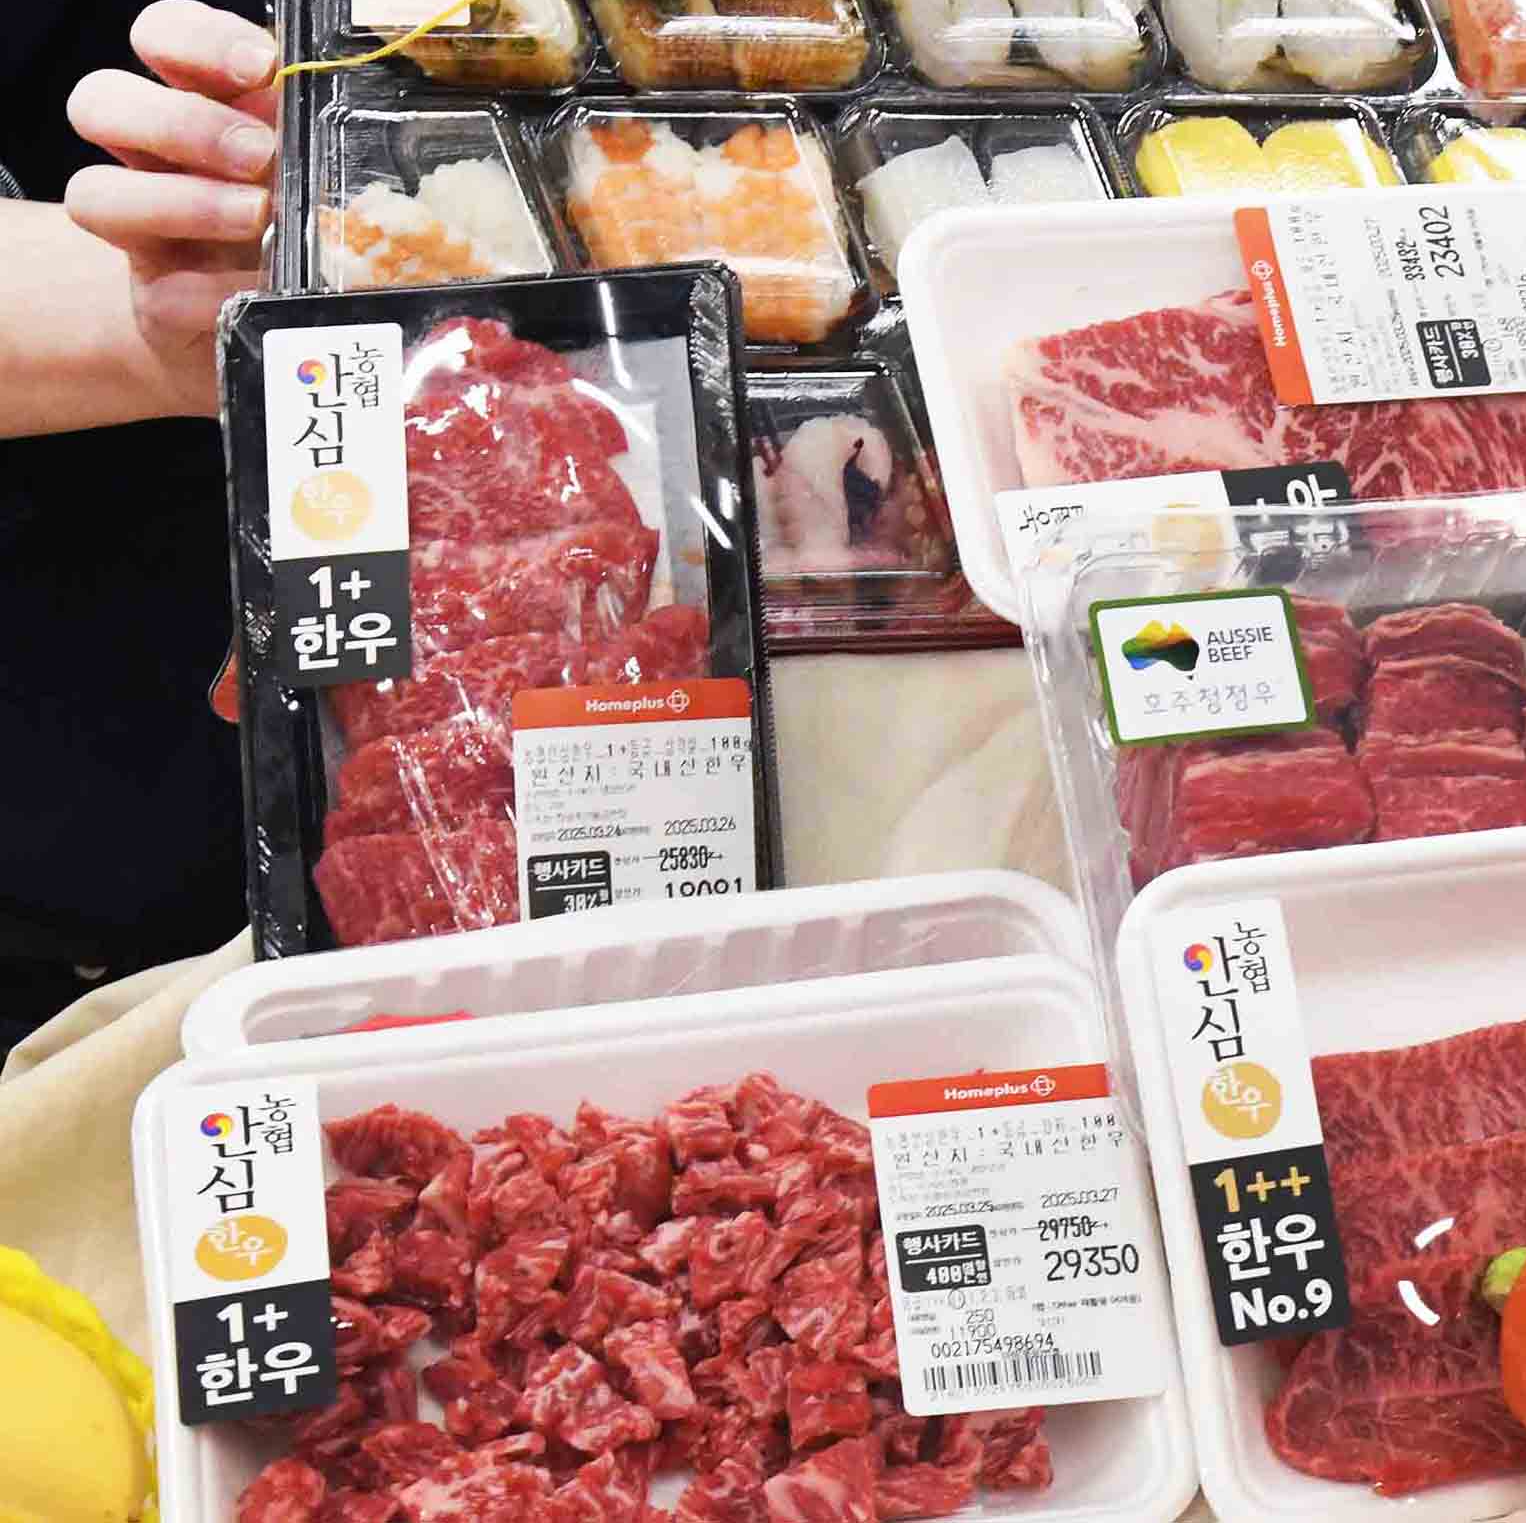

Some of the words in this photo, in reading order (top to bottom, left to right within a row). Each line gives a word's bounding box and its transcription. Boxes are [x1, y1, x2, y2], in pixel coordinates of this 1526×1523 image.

[1419, 205, 1464, 278] 23402
[1263, 280, 1287, 348] Homeplus
[351, 342, 384, 409] 농협
[292, 352, 353, 468] 안심
[307, 565, 372, 609] 1+
[290, 612, 397, 671] 한우
[1206, 626, 1274, 645] AUSSIE
[1207, 645, 1254, 663] BEEF
[585, 699, 664, 713] Homeplus
[1232, 921, 1271, 995] 농협
[1184, 935, 1245, 1062] 안심
[944, 1083, 1029, 1101] Homeplus
[259, 1094, 296, 1155] 농협
[197, 1105, 265, 1214] 안심
[1214, 1165, 1312, 1213] 1++
[207, 1219, 273, 1267] 한우
[902, 1230, 982, 1255] 행사카드
[1038, 1216, 1093, 1242] 29750
[1217, 1212, 1325, 1282] 한우
[1044, 1244, 1139, 1282] 29350
[216, 1302, 289, 1344] 1+
[1229, 1278, 1333, 1331] No.9
[196, 1341, 320, 1407] 한우
